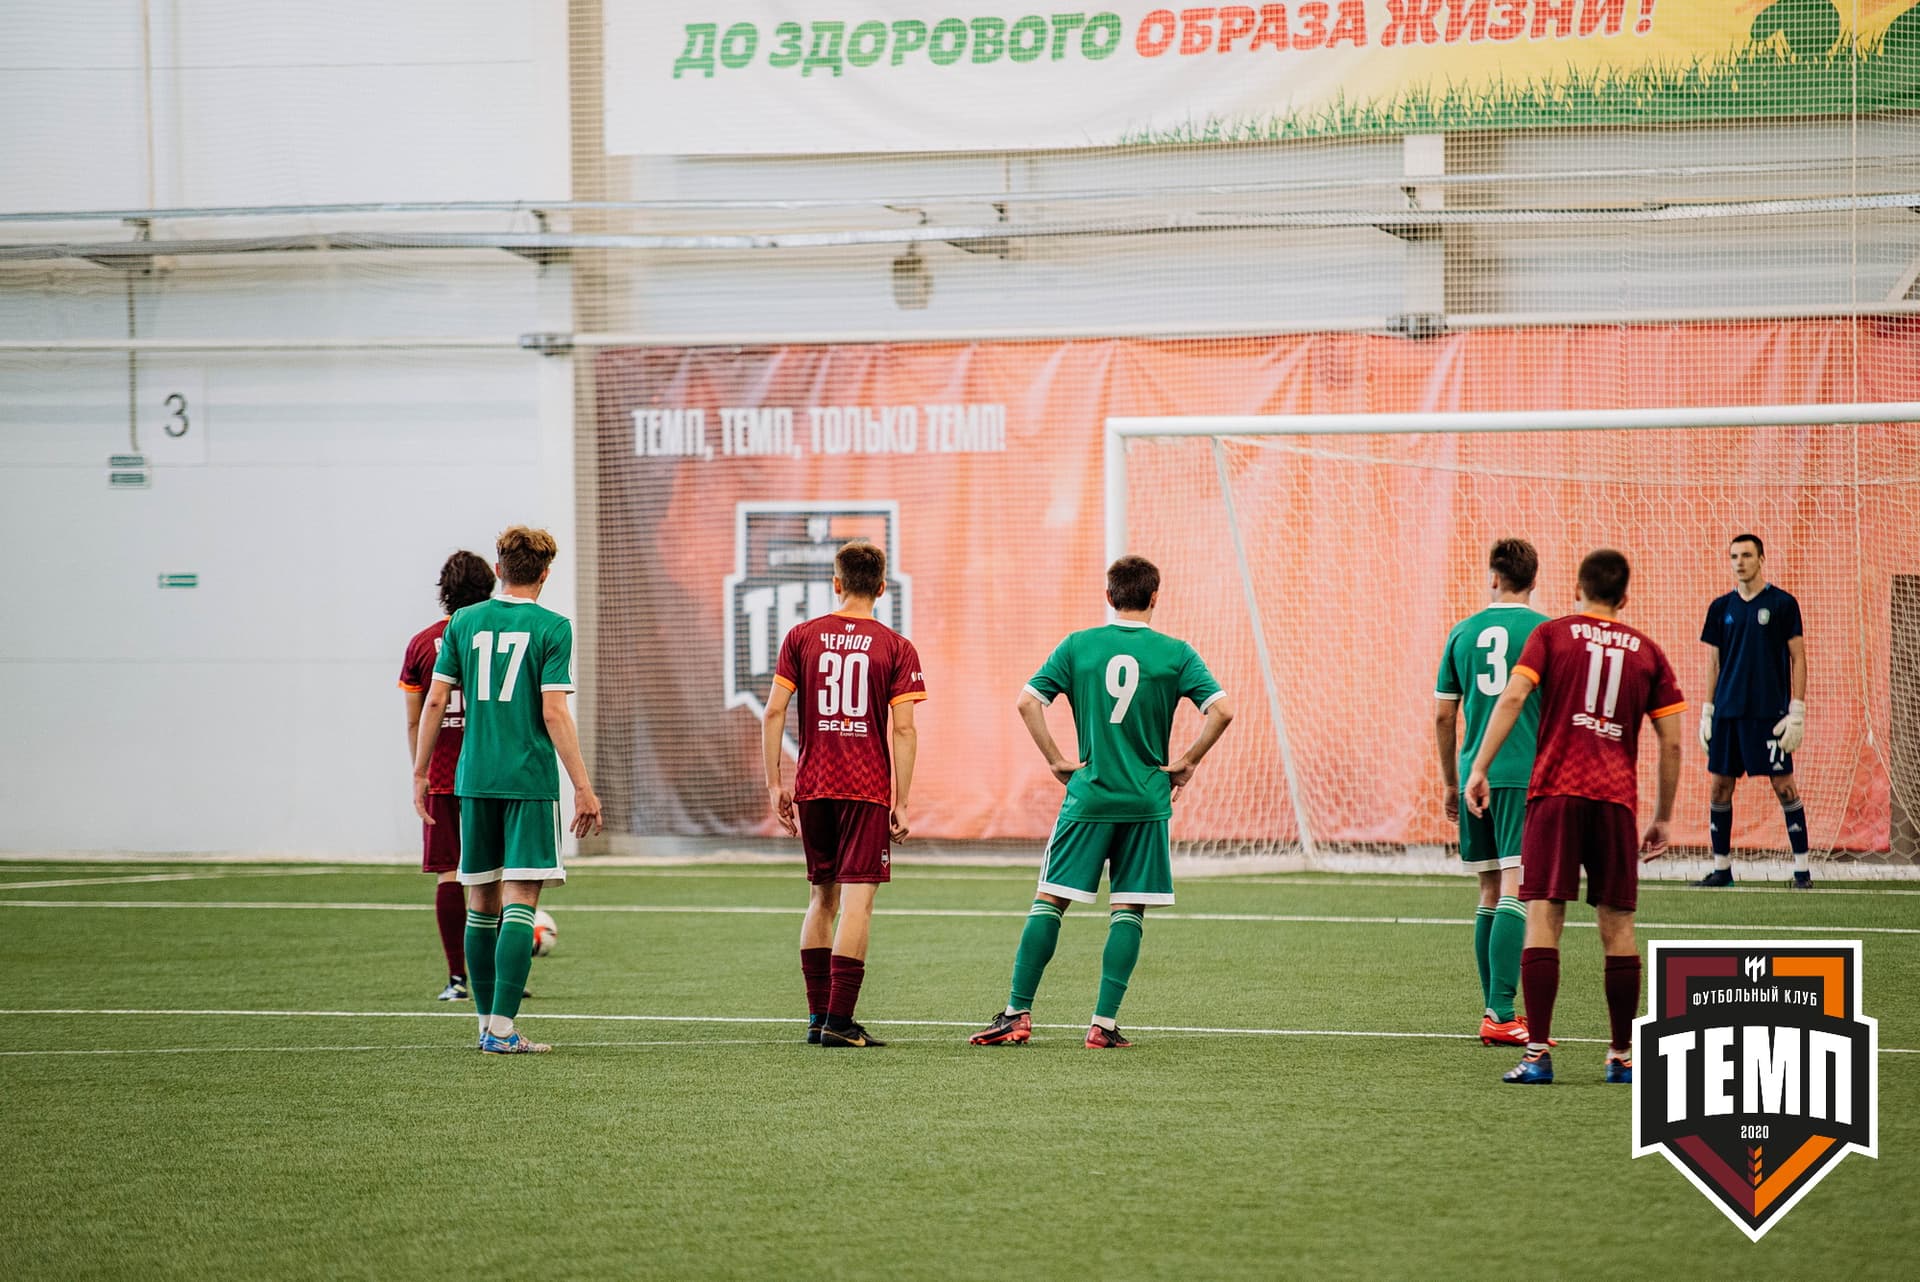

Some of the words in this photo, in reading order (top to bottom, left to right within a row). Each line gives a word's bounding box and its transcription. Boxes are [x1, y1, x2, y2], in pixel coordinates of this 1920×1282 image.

[672, 22, 759, 79] ДО
[768, 12, 1121, 77] ЗДОРОВОГО
[1135, 0, 1367, 58] ОБРАЗА
[163, 392, 189, 438] 3
[631, 408, 714, 462] ТЕМП,
[720, 407, 802, 461] ТЕМП,
[808, 405, 918, 455] ТОЛЬКО
[924, 403, 1007, 454] ТЕМП!
[472, 630, 530, 701] 17
[820, 632, 872, 651] ЧЕРНОВ
[1476, 626, 1509, 696] 3
[1570, 623, 1641, 652] РОДИЧЕВ
[818, 651, 870, 717] 30
[1105, 654, 1140, 724] 9
[1585, 641, 1625, 718] 11
